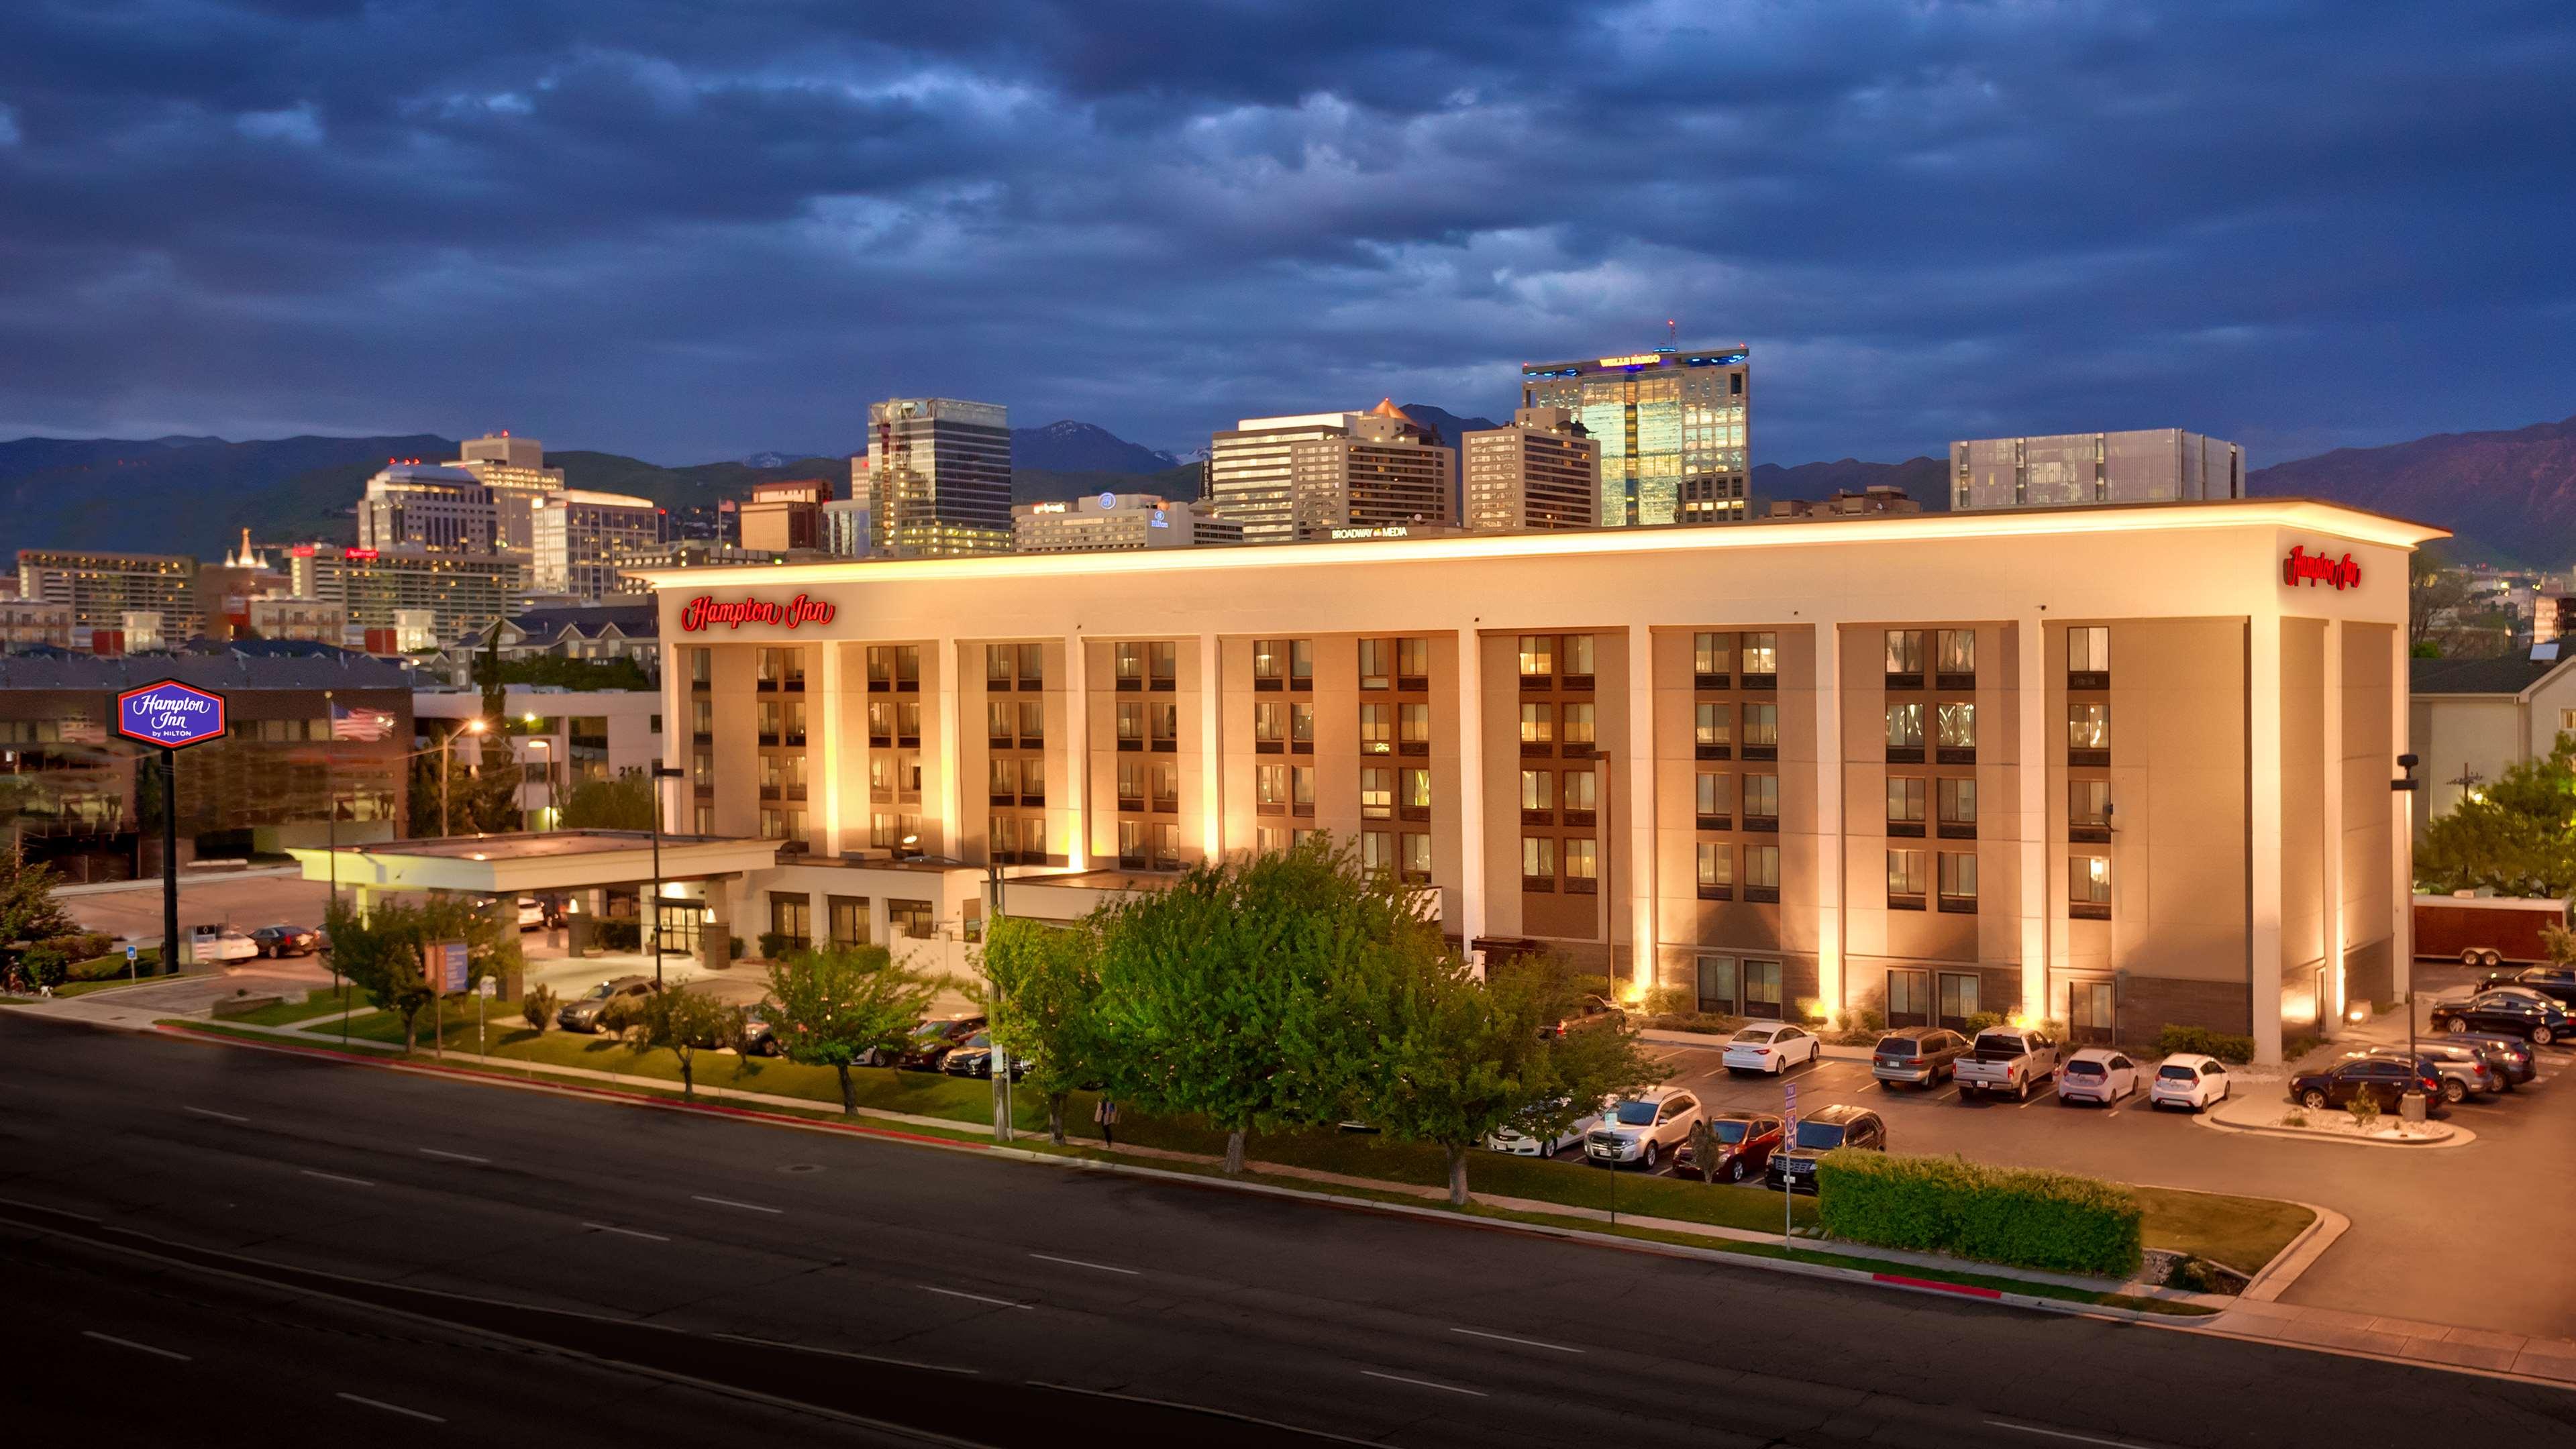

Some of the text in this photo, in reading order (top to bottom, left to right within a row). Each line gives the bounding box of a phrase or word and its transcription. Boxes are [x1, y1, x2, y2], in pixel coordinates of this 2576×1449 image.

[1600, 354, 1660, 367] WELLS FARGO
[1331, 527, 1408, 539] BROADWAY MEDIA
[2283, 545, 2361, 590] Hampton Inn
[682, 593, 836, 632] Hampton Inn
[133, 694, 211, 715] Hampton
[151, 711, 187, 729] Inn
